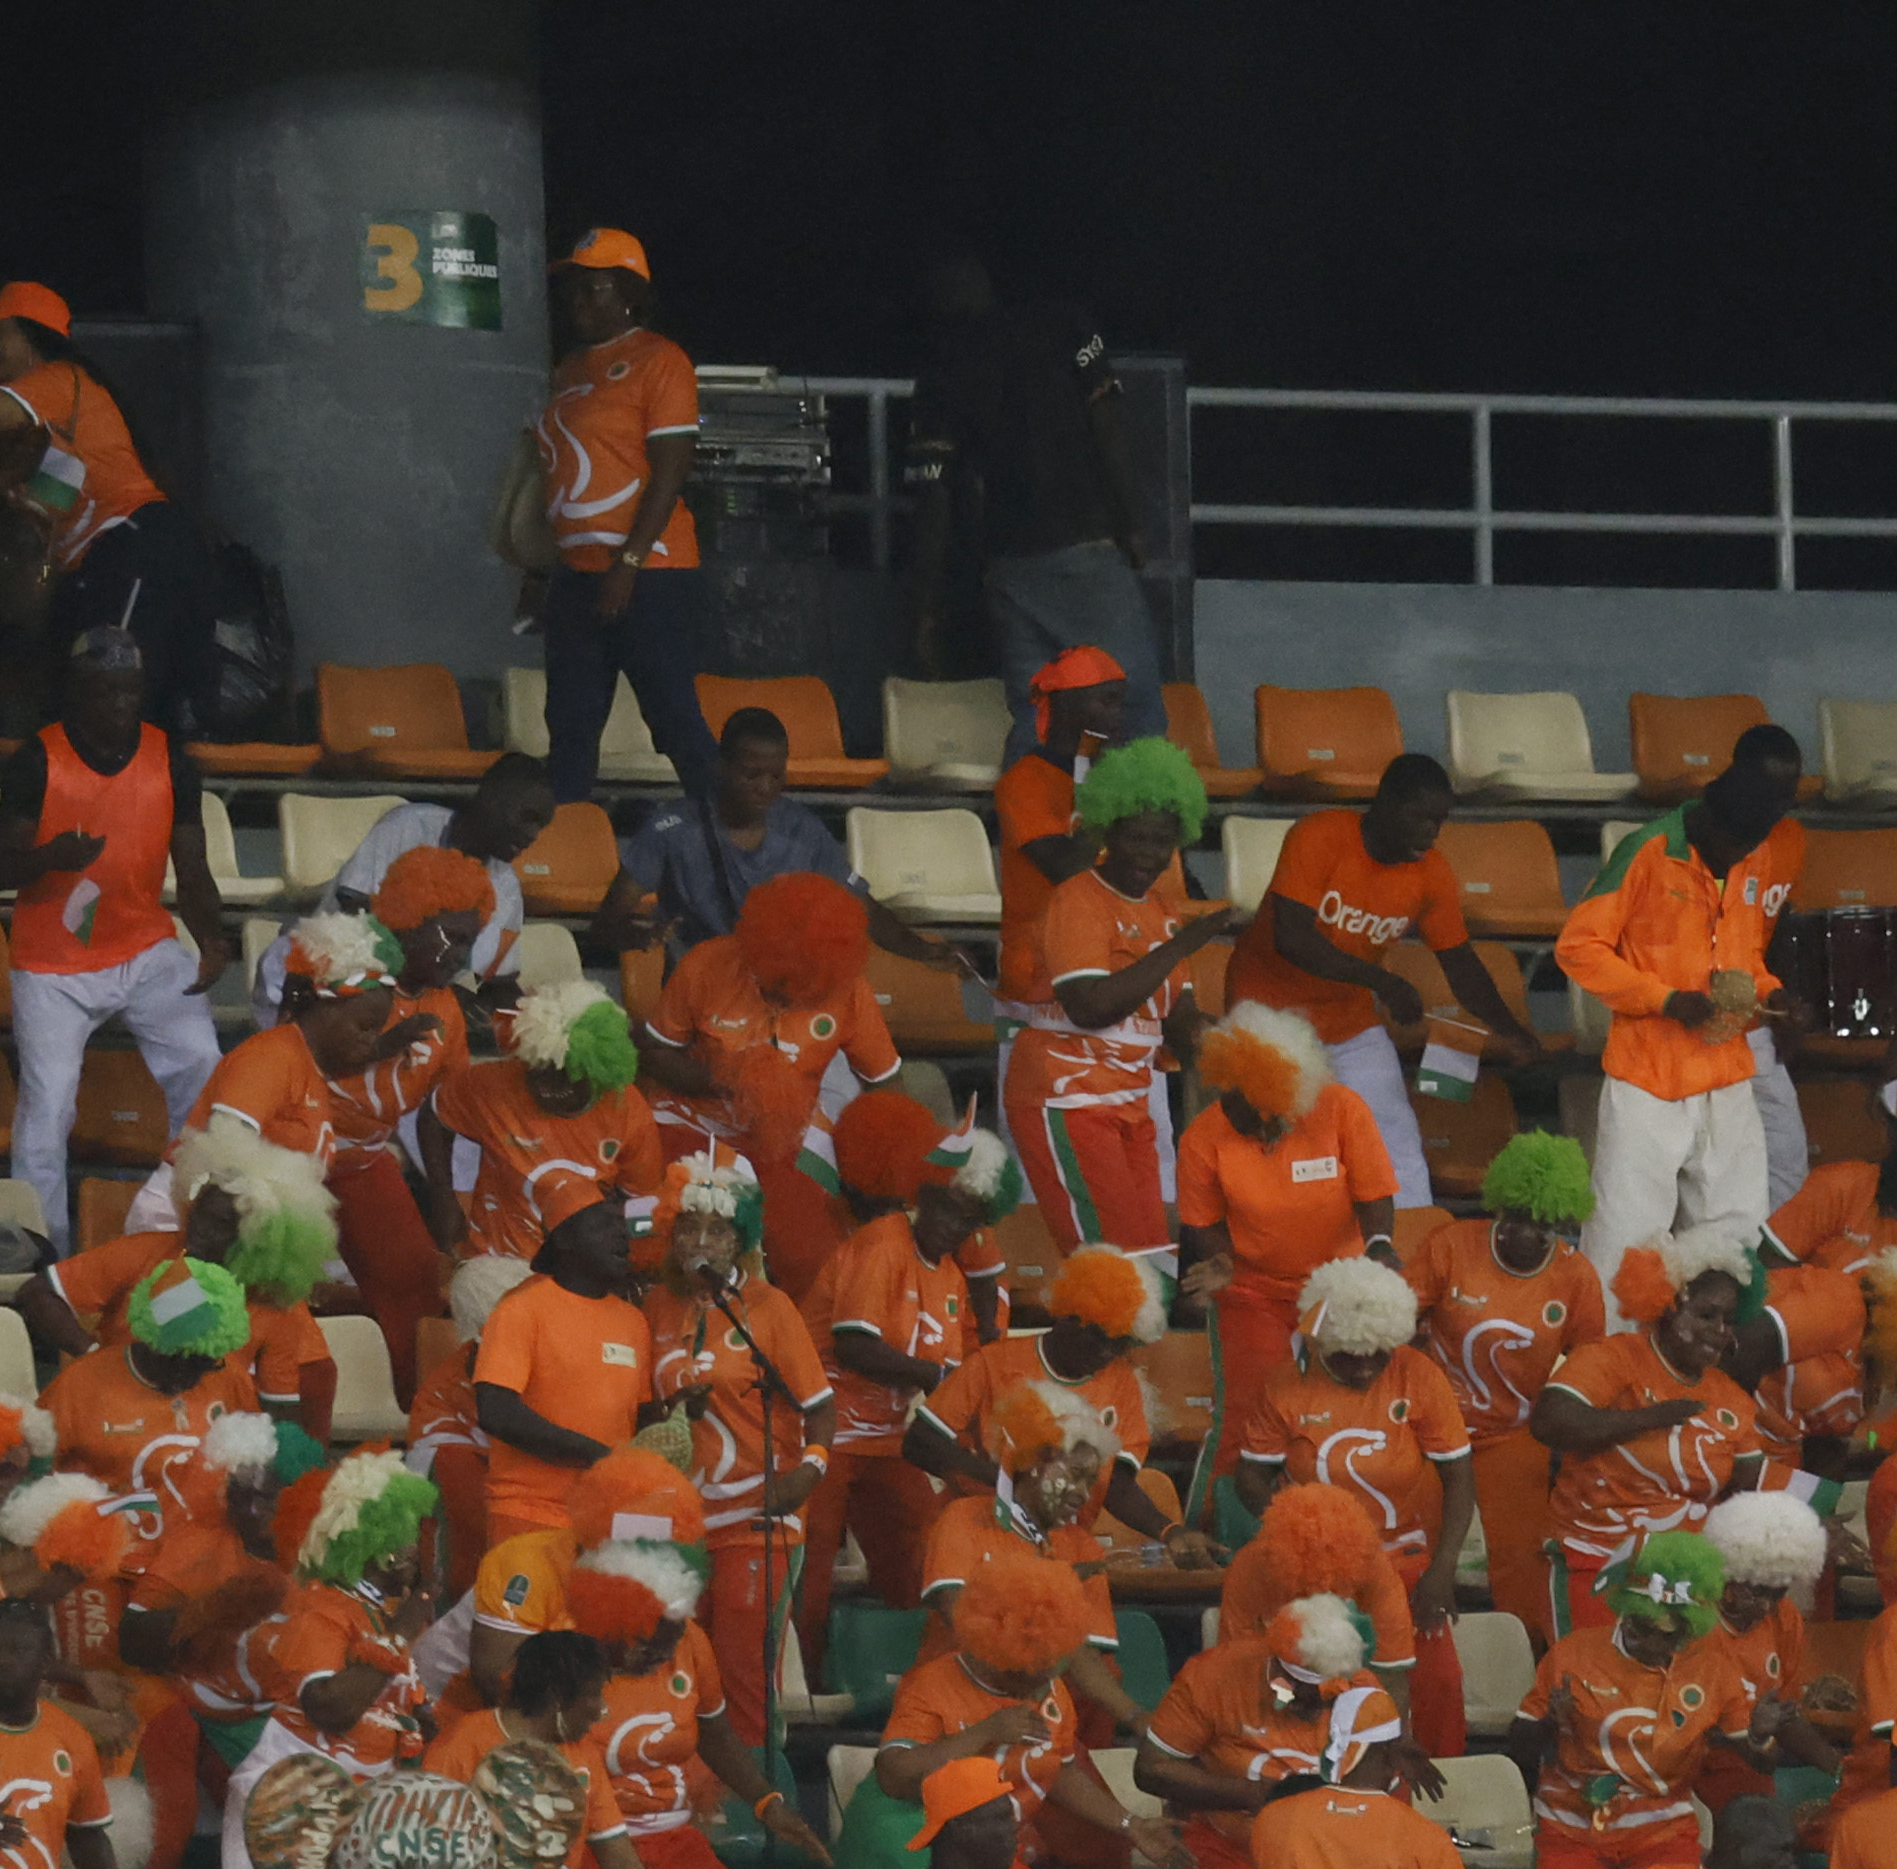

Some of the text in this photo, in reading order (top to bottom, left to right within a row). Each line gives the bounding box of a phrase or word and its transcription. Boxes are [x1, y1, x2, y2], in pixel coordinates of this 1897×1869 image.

[364, 223, 425, 313] 3
[1319, 889, 1410, 945] Orange
[375, 1827, 466, 1862] CNSE
